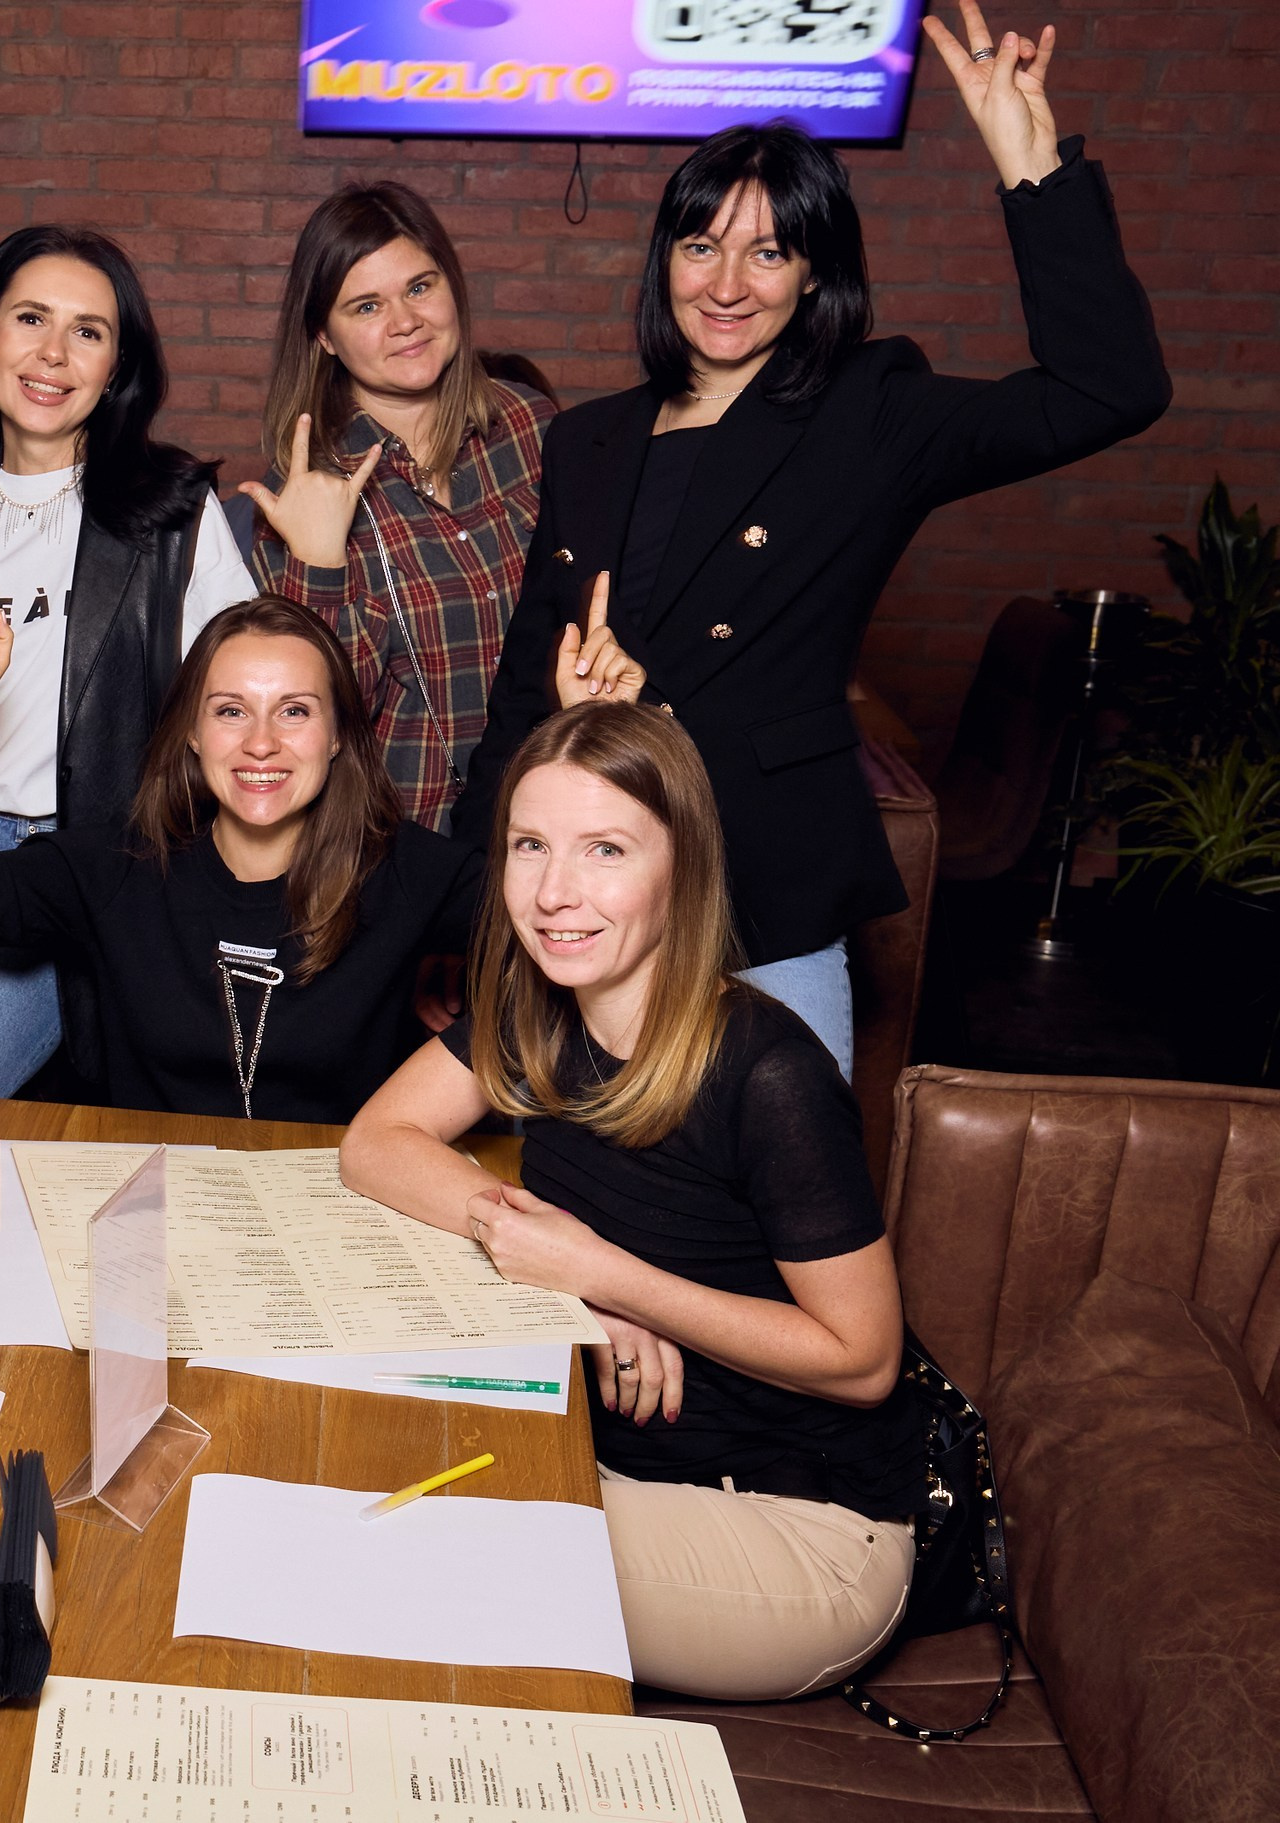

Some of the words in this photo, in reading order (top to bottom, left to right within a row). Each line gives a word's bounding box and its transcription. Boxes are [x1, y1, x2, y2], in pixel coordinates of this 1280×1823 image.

[308, 60, 616, 102] MUZLOTO
[51, 1752, 60, 1773] БЛЮДА
[56, 1707, 66, 1739] КОМПАНИЮ
[410, 1774, 421, 1800] ДЕСЕРТЫ
